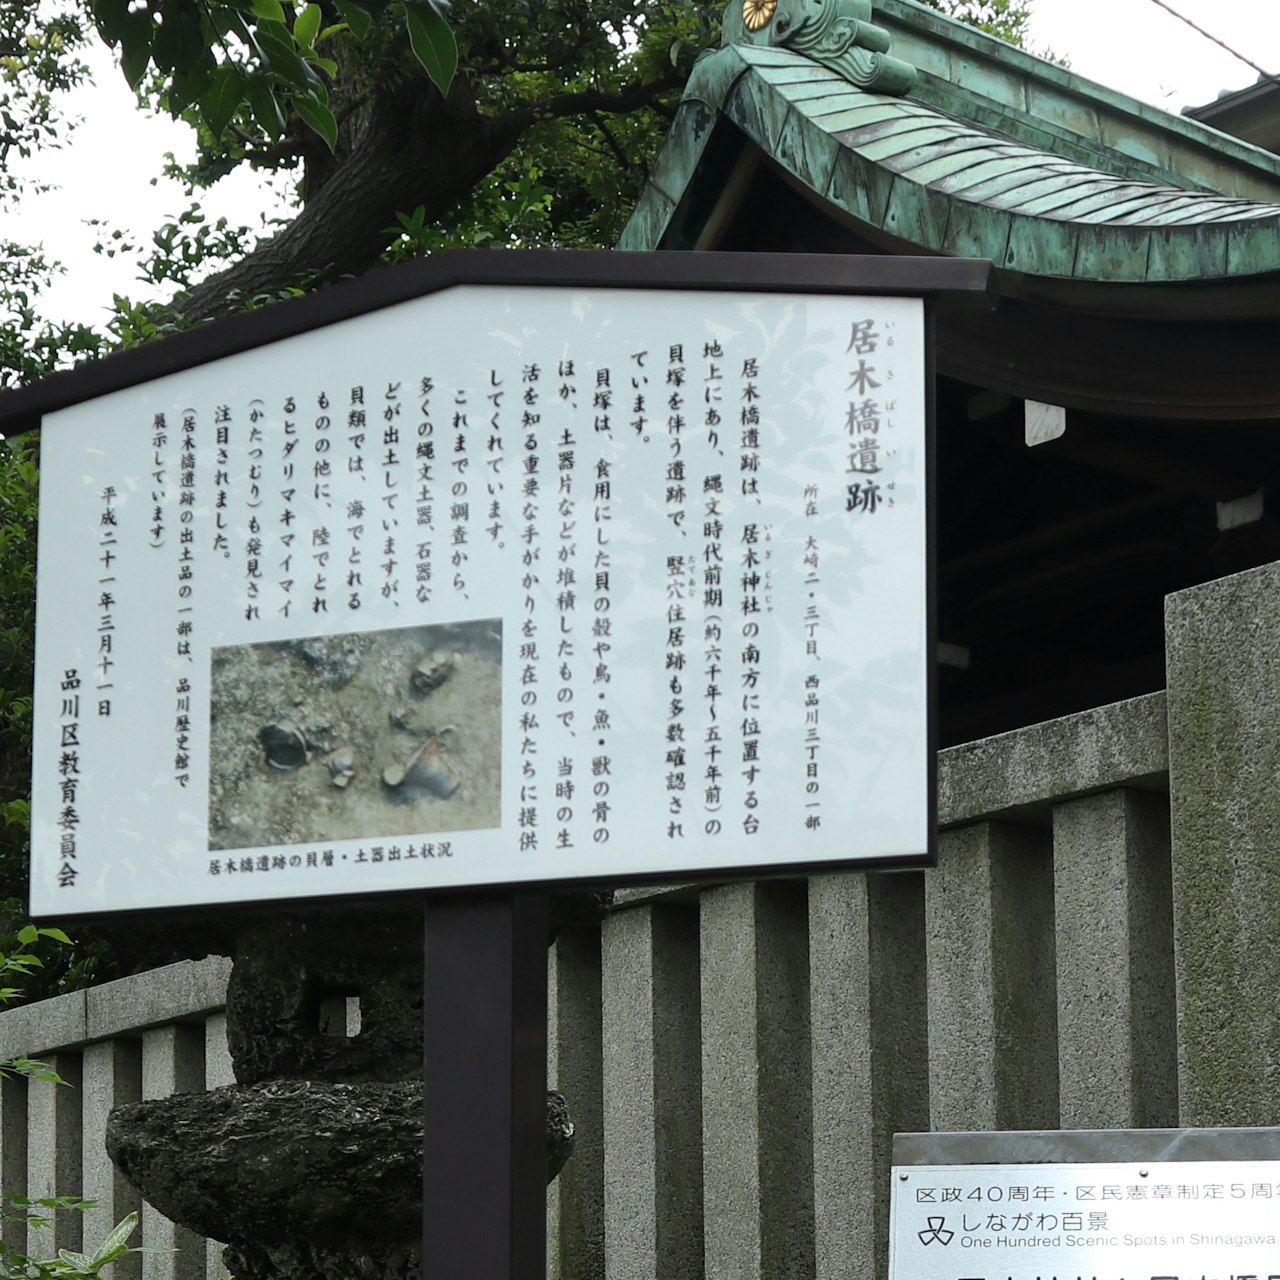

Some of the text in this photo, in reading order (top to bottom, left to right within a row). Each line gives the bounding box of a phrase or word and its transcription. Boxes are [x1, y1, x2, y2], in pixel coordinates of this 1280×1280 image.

[149, 412, 168, 549] 展示しています）
[213, 404, 232, 559] 注目されました。
[278, 396, 299, 618] るヒダリマキマイマイ
[312, 391, 332, 614] ものの他に、陸でとれ
[346, 385, 367, 611] 貝類では、海でとれる
[380, 381, 402, 607] どが出土していますが、
[416, 376, 435, 603] 多くの縄文土器、石器な
[449, 390, 470, 600] これまでの調査から、
[485, 369, 505, 549] してくれています。
[629, 350, 650, 444] ています。
[844, 319, 883, 514] 居木橋遺跡
[96, 486, 118, 718] 平成二十一年三月十一日
[244, 399, 264, 621] （かたつむり）も発見され
[518, 363, 541, 851] 活を知る重要な手がかりを現在の私たちに提供
[555, 360, 577, 849] ほか、土器片などが堆積したもので、当時の生
[591, 368, 613, 843] 貝塚は、食用にした貝の殻や鳥・魚・獣の骨の
[665, 343, 687, 839] 貝塚を伴う遺跡で、竪穴住居跡も多数確認され
[739, 357, 762, 835] 居木橋遺跡は、居木神社の南方に位置する台
[803, 483, 821, 831] 所在 大崎二・三丁目、西品川三丁目の一部
[56, 668, 82, 888] 品川区教育委員会
[207, 842, 453, 876] 居木橋遺跡の貝層・土器出土状況
[961, 1233, 1276, 1248] One Hundred Scenic Spots in Shinagawa
[962, 1212, 1109, 1231] しながわ百景
